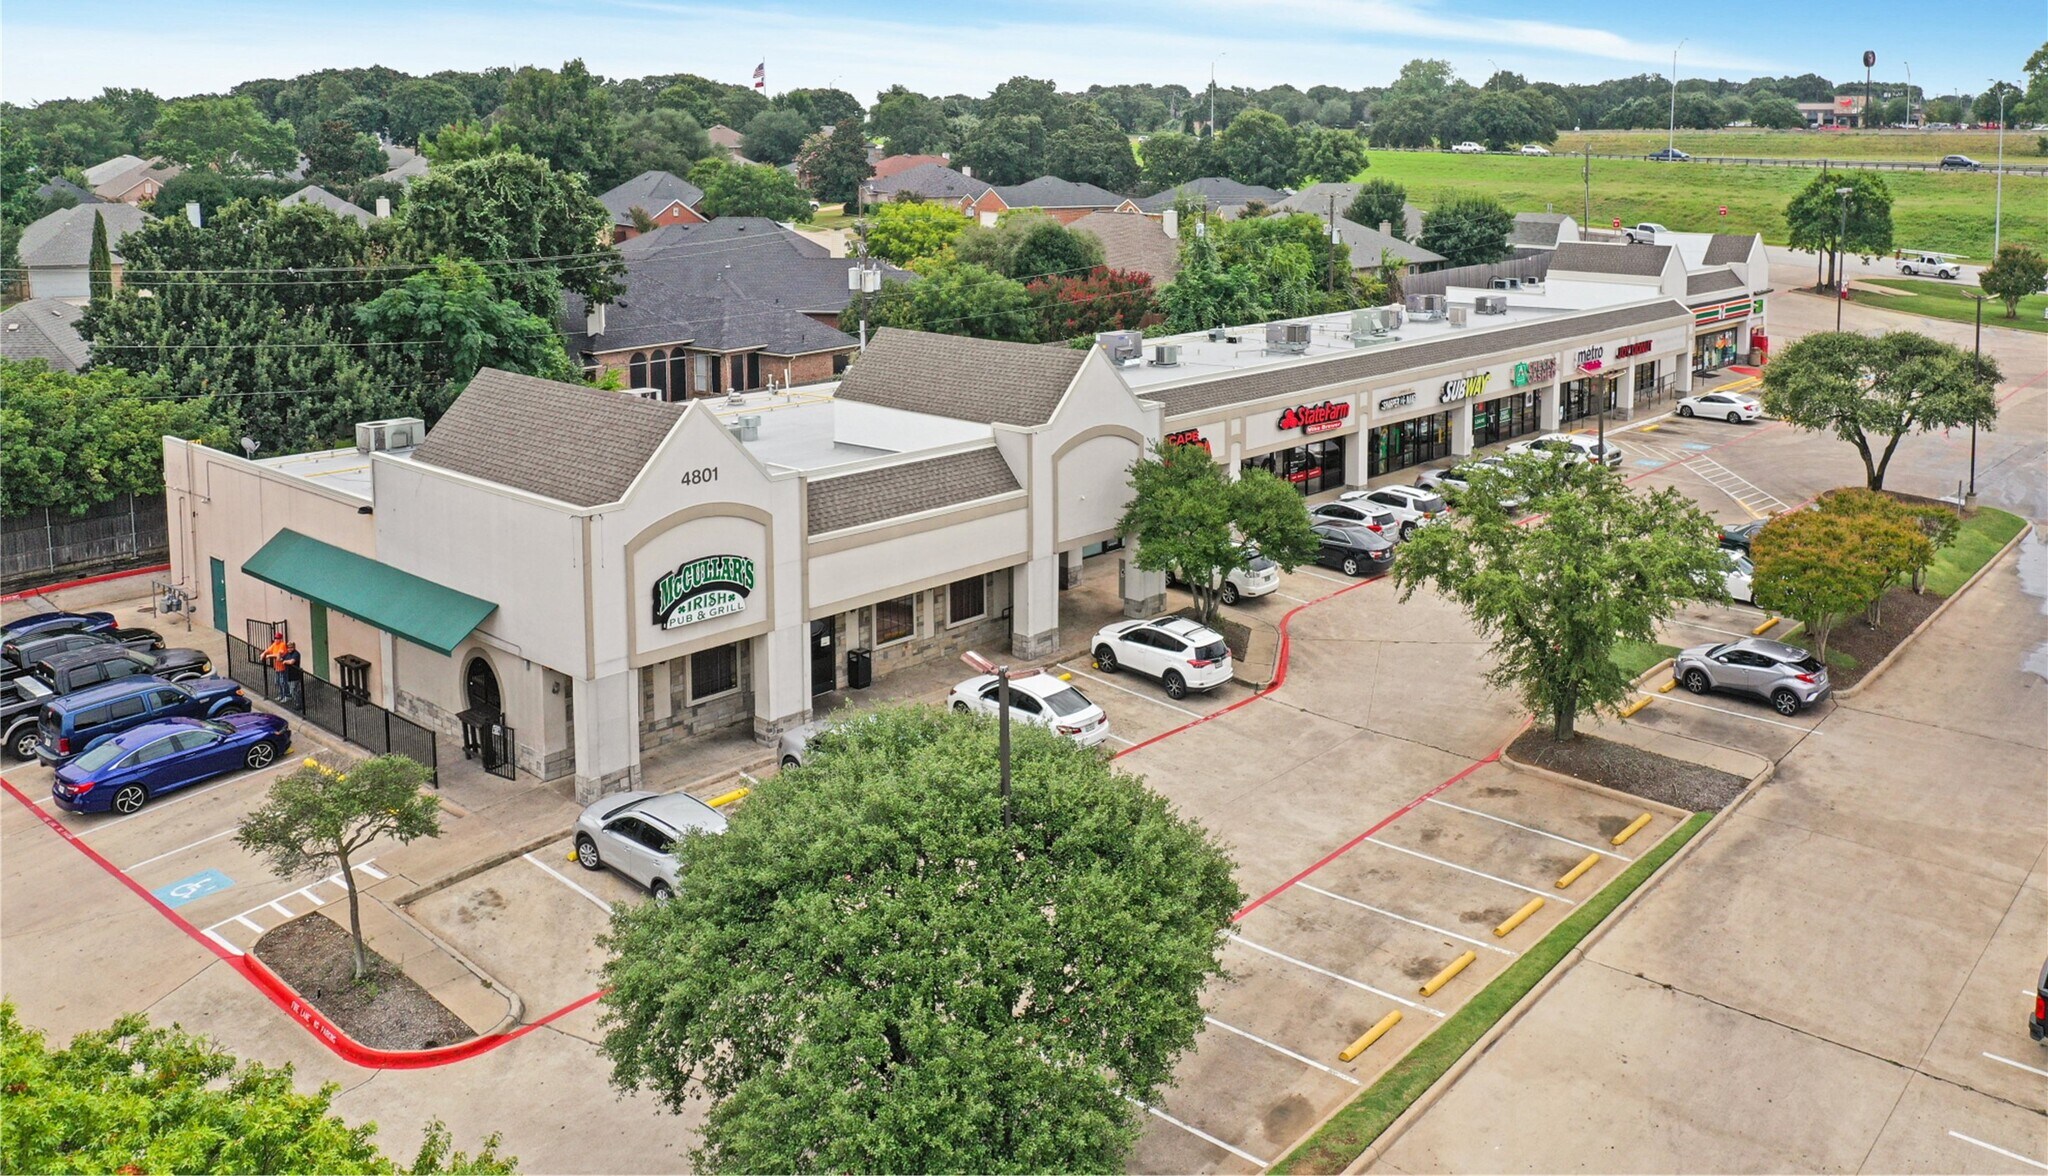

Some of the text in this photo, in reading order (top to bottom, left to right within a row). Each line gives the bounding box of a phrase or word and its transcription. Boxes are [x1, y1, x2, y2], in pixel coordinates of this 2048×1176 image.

[1578, 345, 1603, 363] metro
[1442, 373, 1491, 403] SUBWAY
[681, 466, 718, 486] 4801
[659, 557, 756, 616] McCULLAR'S
[687, 592, 727, 612] IRISH
[669, 602, 744, 627] PUB & GRILL
